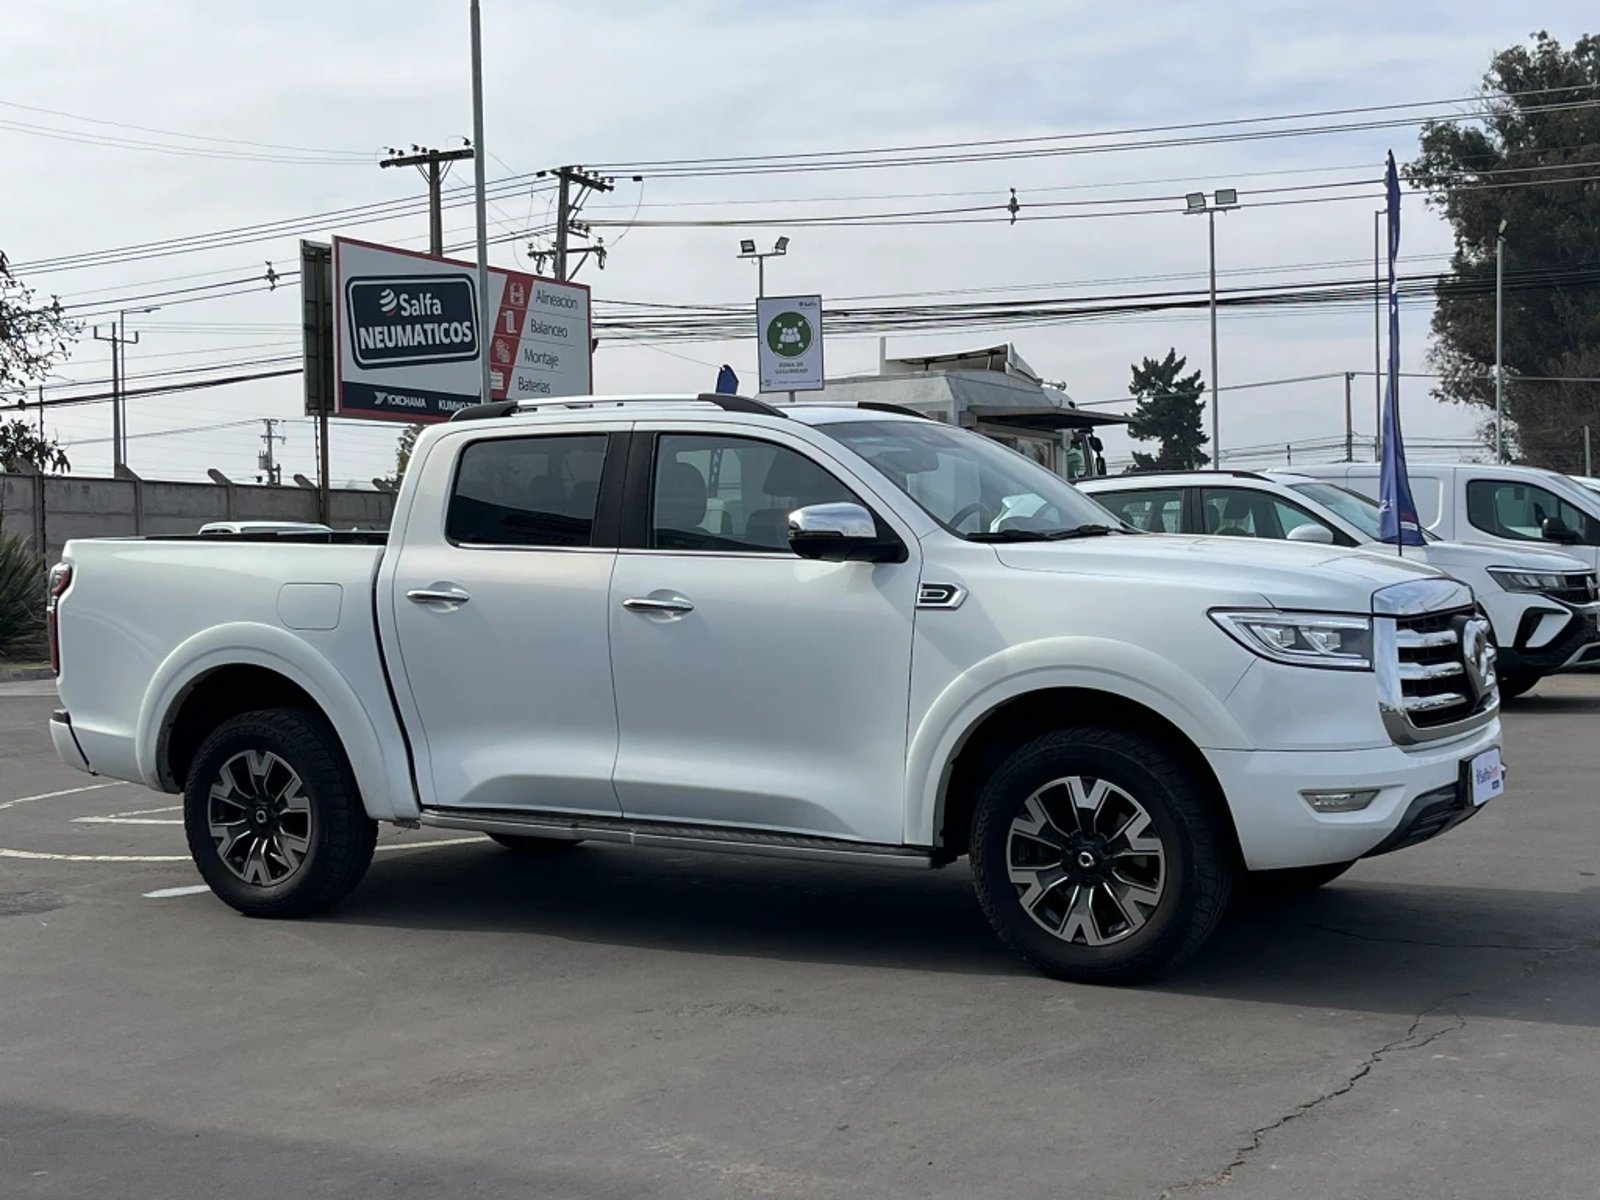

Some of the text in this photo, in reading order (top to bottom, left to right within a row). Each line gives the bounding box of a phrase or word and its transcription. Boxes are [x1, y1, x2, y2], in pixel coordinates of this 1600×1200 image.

[399, 293, 442, 316] Salfa
[535, 289, 579, 310] Alineación
[359, 321, 473, 350] NEUMATICOS
[530, 318, 568, 339] Balanceo
[524, 347, 559, 369] Montaje
[518, 376, 551, 394] Baterías
[387, 394, 427, 408] YOKOHAMA
